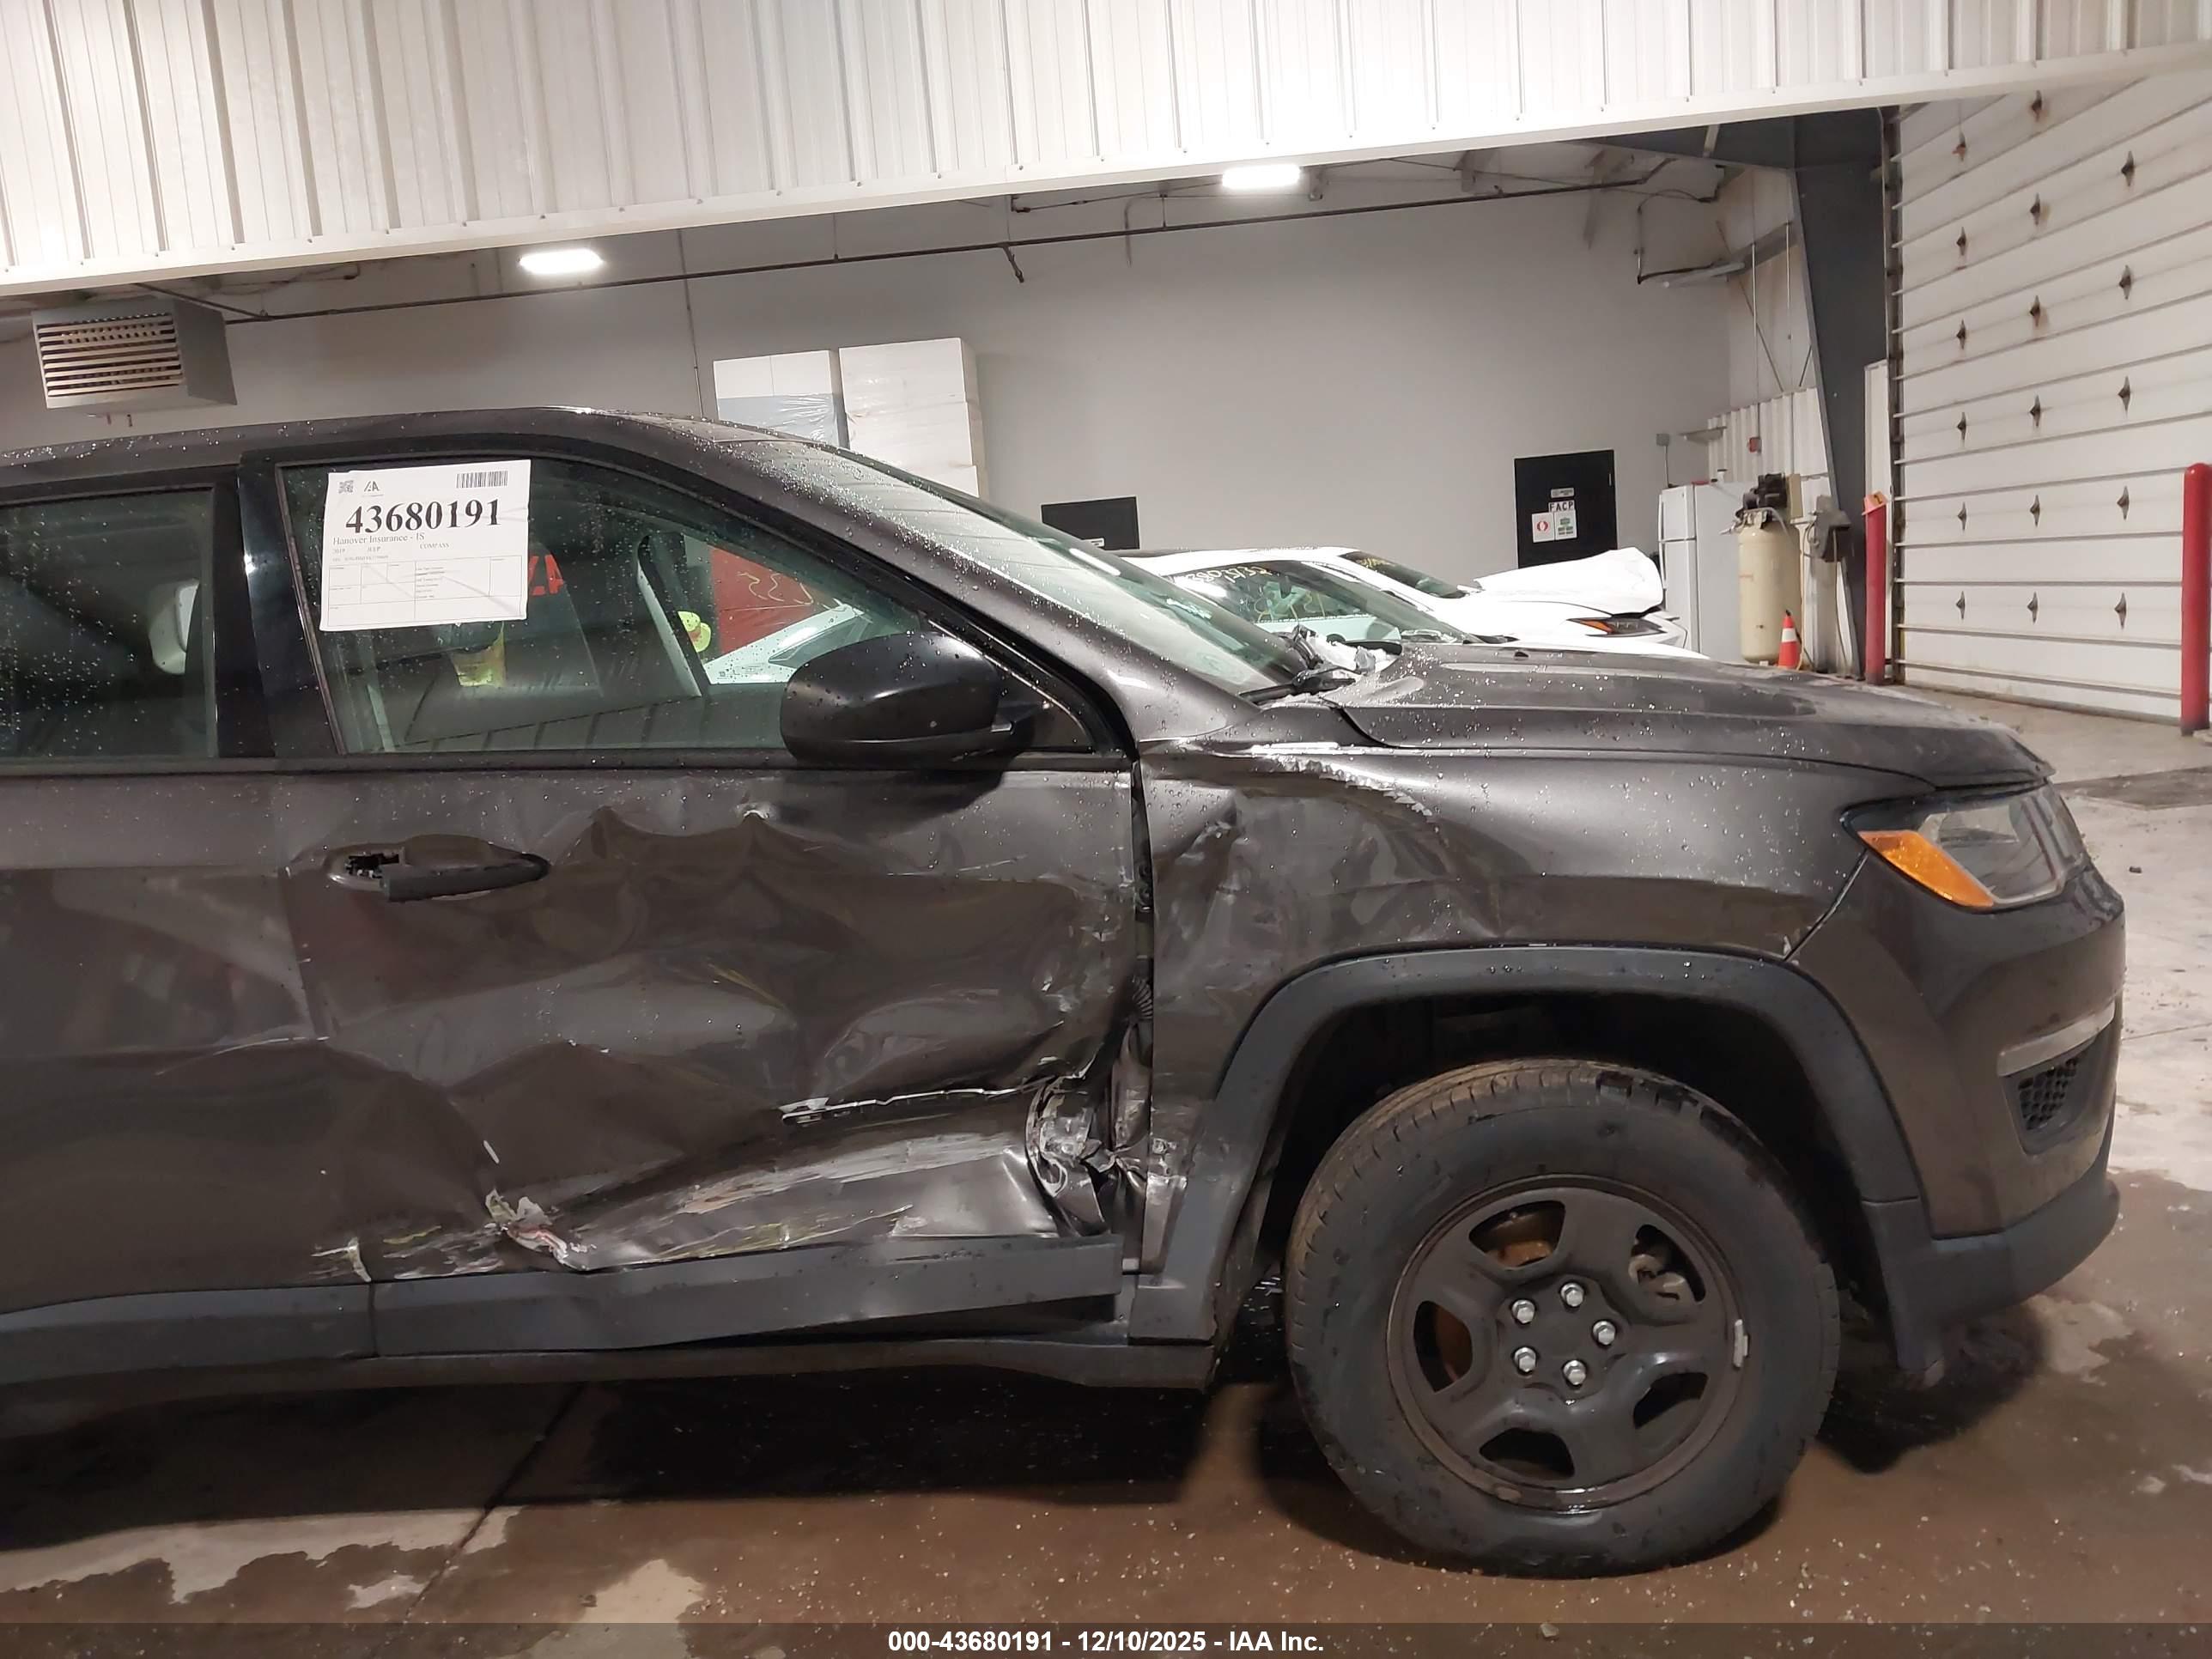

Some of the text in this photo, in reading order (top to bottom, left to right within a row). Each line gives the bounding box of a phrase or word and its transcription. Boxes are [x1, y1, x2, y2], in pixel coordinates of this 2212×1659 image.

[1549, 501, 1574, 512] FACP
[345, 498, 501, 533] 43680191
[332, 536, 368, 545] Hanover
[369, 534, 408, 544] Insurance
